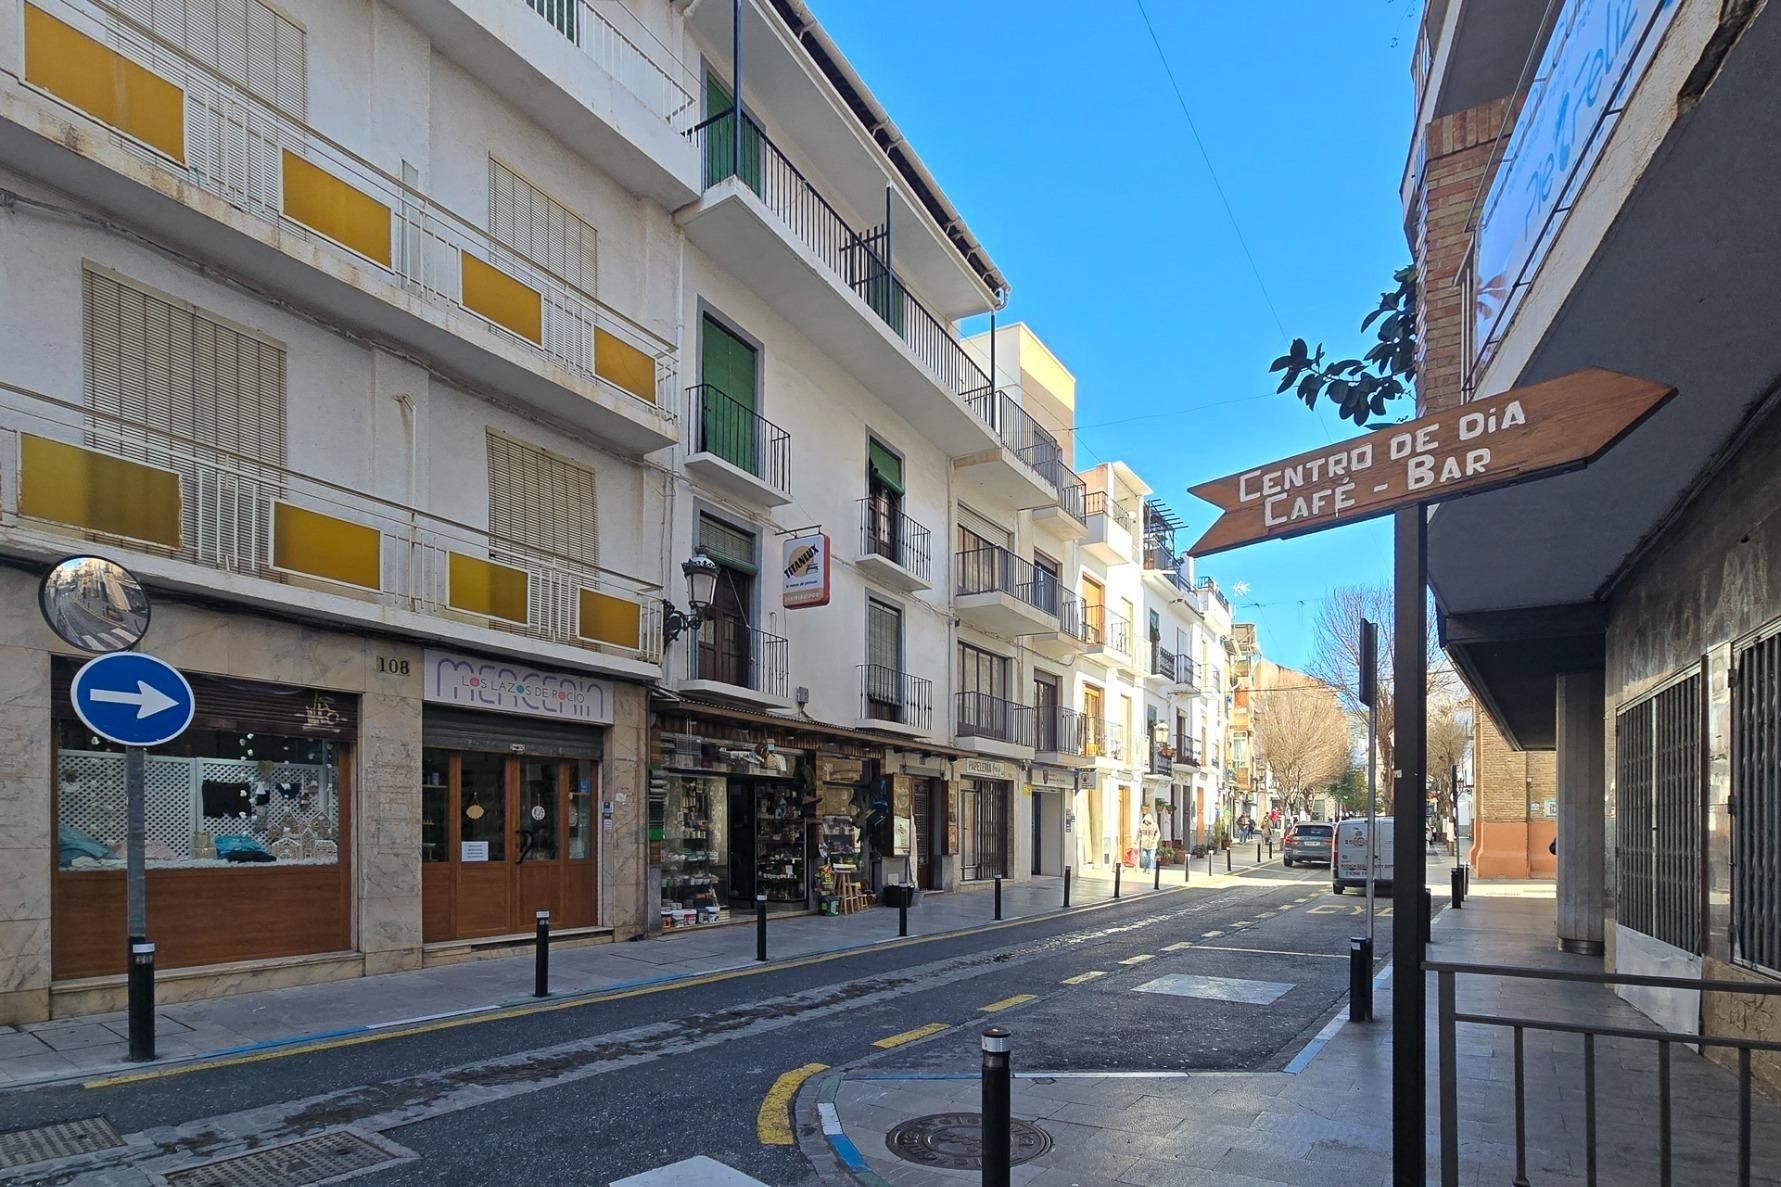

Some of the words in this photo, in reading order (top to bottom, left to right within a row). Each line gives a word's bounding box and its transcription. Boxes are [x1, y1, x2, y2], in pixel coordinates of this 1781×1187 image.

[1239, 443, 1373, 502] CENTRO
[1390, 423, 1440, 460] DE
[1265, 477, 1356, 527] CAFÉ
[1408, 448, 1491, 490] BAR
[784, 543, 819, 579] TITANLUX
[379, 656, 410, 675] 108
[462, 676, 488, 689] LOS
[491, 681, 532, 696] LAZOS
[535, 686, 549, 698] DE
